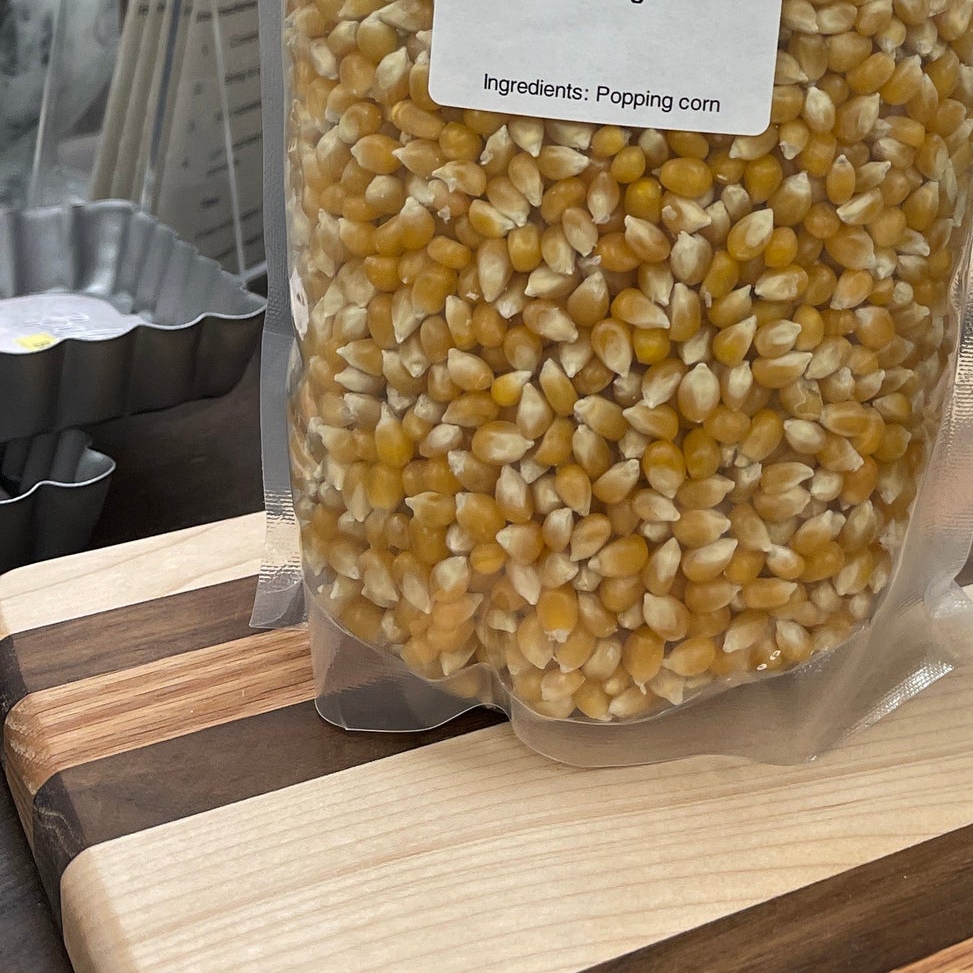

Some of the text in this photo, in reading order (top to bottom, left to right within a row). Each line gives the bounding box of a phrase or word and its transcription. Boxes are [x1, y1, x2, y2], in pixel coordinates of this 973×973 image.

[482, 72, 722, 114] Ingredients: Popping corn
